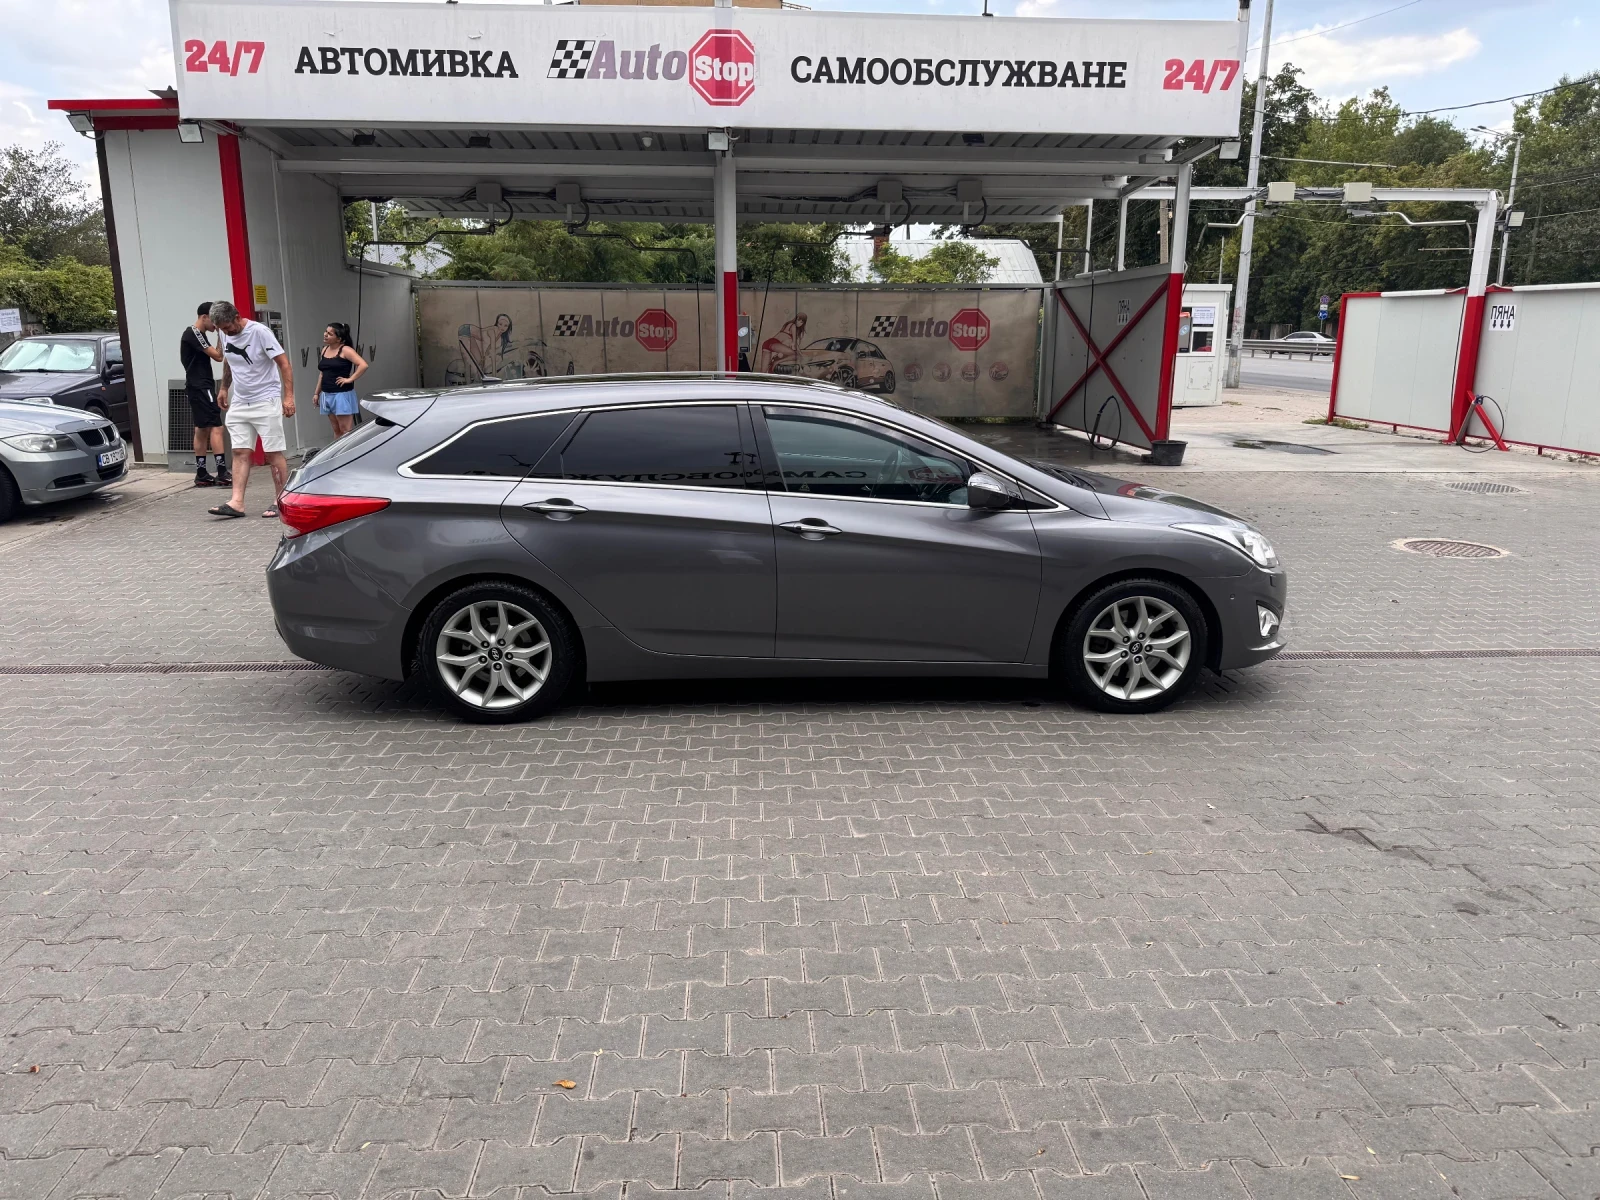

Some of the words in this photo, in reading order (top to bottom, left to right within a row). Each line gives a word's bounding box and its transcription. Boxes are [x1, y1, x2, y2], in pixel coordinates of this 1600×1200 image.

[185, 39, 265, 77] 24/7
[294, 46, 520, 78] АВТОМИВКА
[587, 40, 688, 81] Auto
[695, 55, 754, 87] Stop
[790, 55, 1128, 88] САМООБСЛУЖВАНЕ
[1162, 58, 1241, 94] 24/7
[576, 315, 635, 338] Auto
[639, 323, 674, 342] Stop
[891, 316, 949, 338] Auto
[952, 323, 987, 341] Stop
[1490, 305, 1515, 320] ПЯНА
